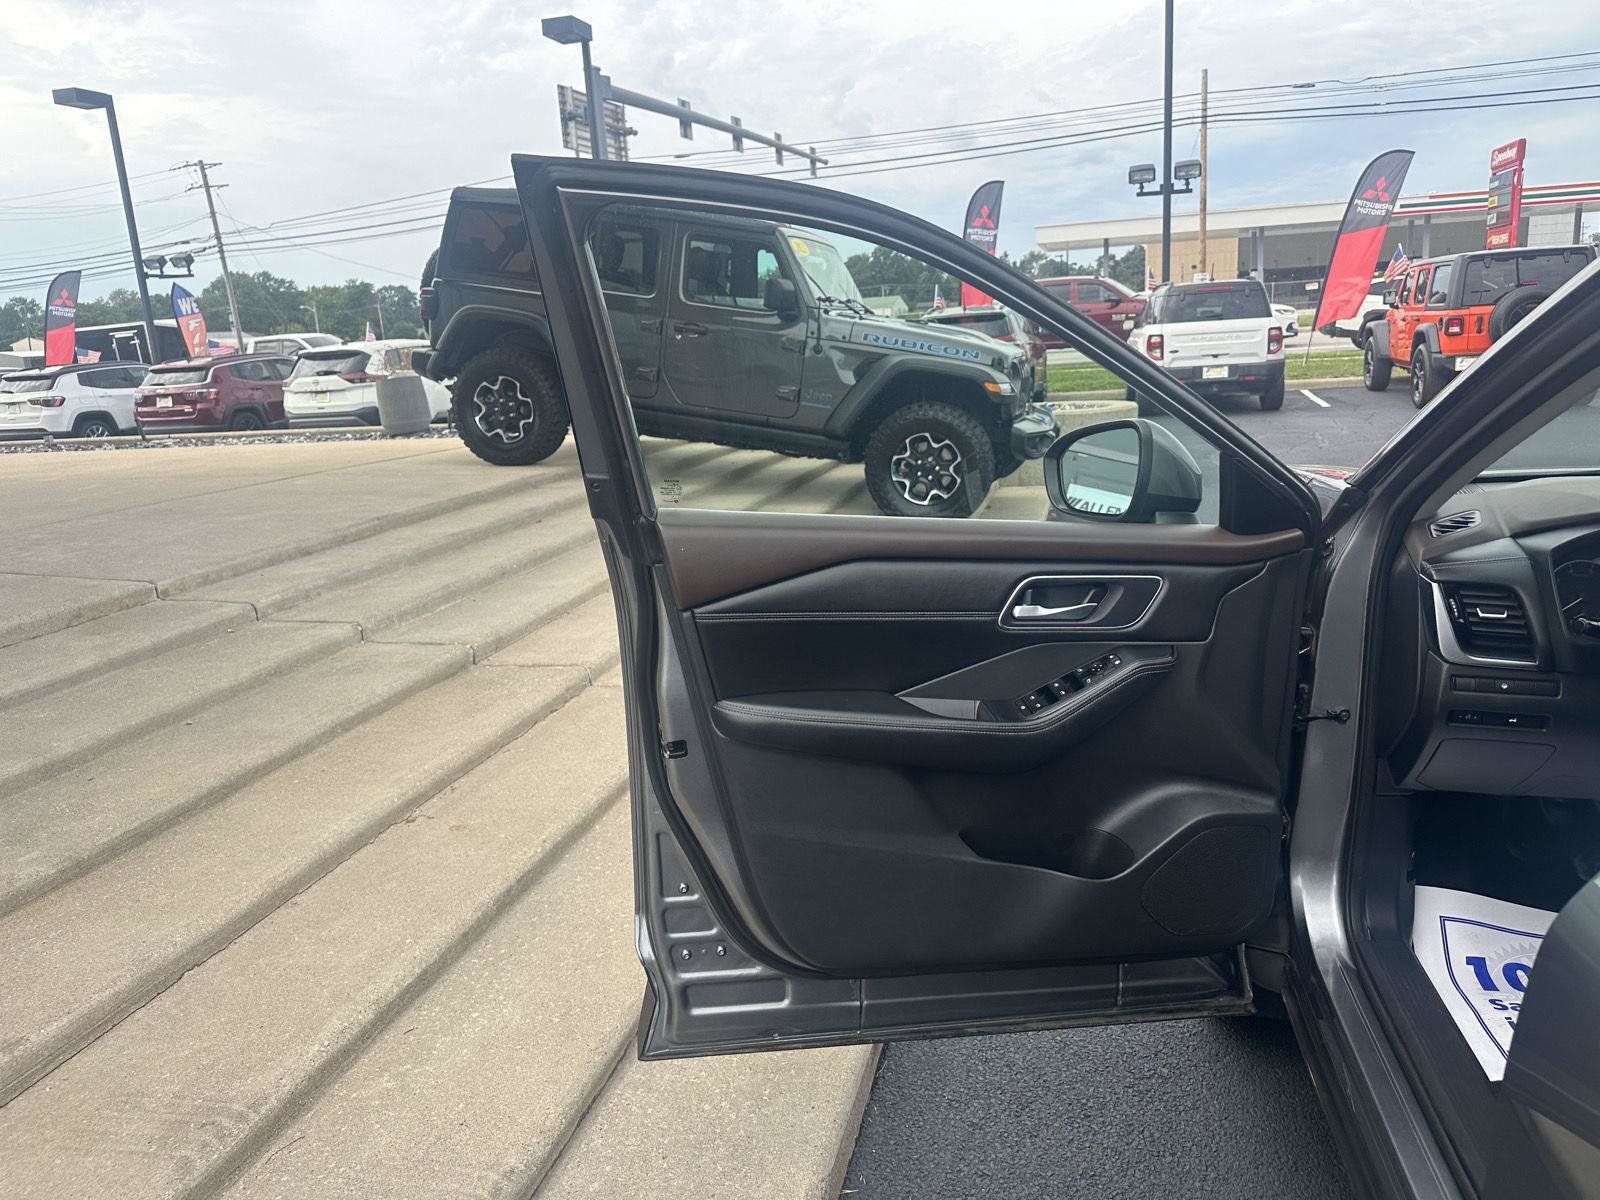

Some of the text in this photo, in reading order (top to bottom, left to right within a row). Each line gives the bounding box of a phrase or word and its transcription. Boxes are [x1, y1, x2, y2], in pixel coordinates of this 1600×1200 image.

[1354, 199, 1393, 211] MITSUBISHI
[1356, 206, 1386, 216] MOTORS
[861, 333, 981, 360] RUBICON
